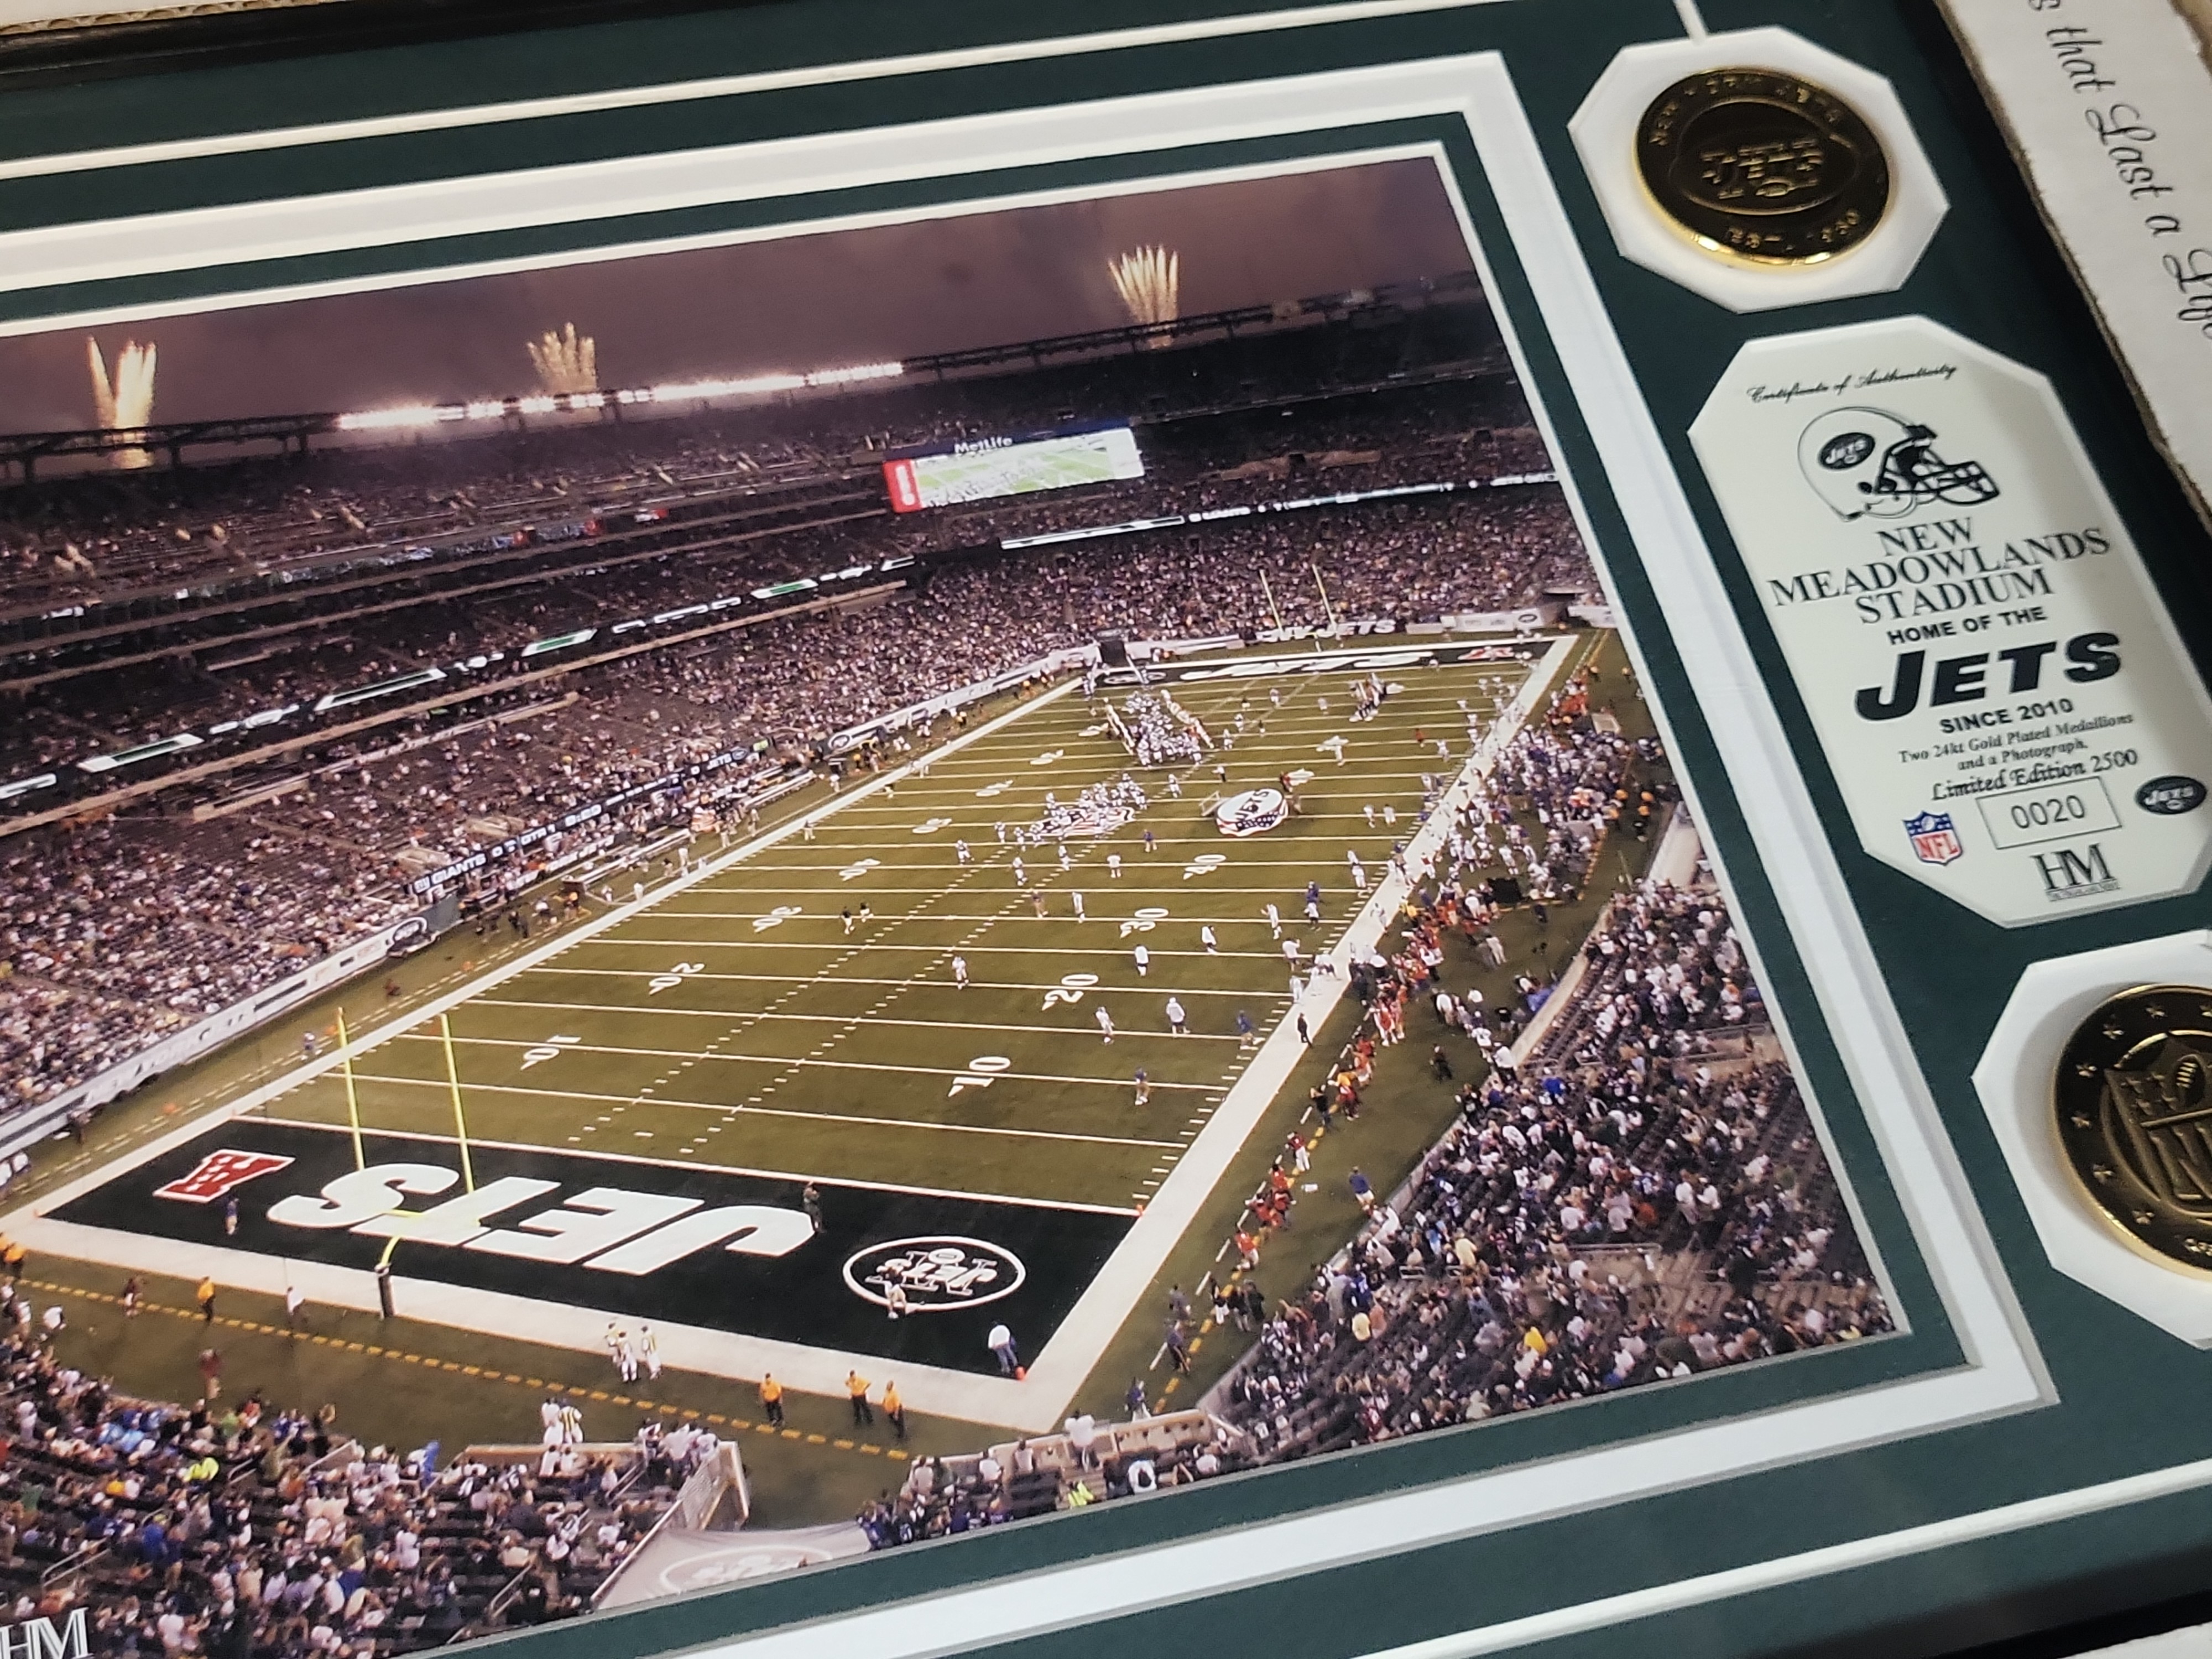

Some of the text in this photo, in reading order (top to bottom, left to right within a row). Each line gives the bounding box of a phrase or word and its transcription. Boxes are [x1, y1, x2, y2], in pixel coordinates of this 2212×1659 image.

[2046, 27, 2116, 93] that
[2085, 103, 2174, 200] Last
[2145, 215, 2181, 238] a
[1833, 374, 1852, 395] of
[954, 437, 1013, 453] MetLife
[1876, 517, 1974, 557] NEW
[1767, 527, 2111, 607] MEADOWLANDS
[1855, 567, 2056, 625] STADIUM
[1887, 606, 2047, 645] HOME OF THE
[1854, 632, 2122, 721] JETS
[1940, 698, 2074, 734] SINCE 2010
[1898, 713, 2135, 763] Two 24kt Gold Plated Medallions
[1932, 748, 2139, 801] Limited Edition 2500
[1957, 756, 1985, 771] and
[1988, 755, 1997, 766] a
[2010, 794, 2086, 829] 0020
[1915, 832, 1959, 859] NFL
[2030, 842, 2115, 891] HM
[1044, 973, 1099, 1003] 20
[952, 1056, 1011, 1088] 10
[267, 1163, 816, 1276] JETS
